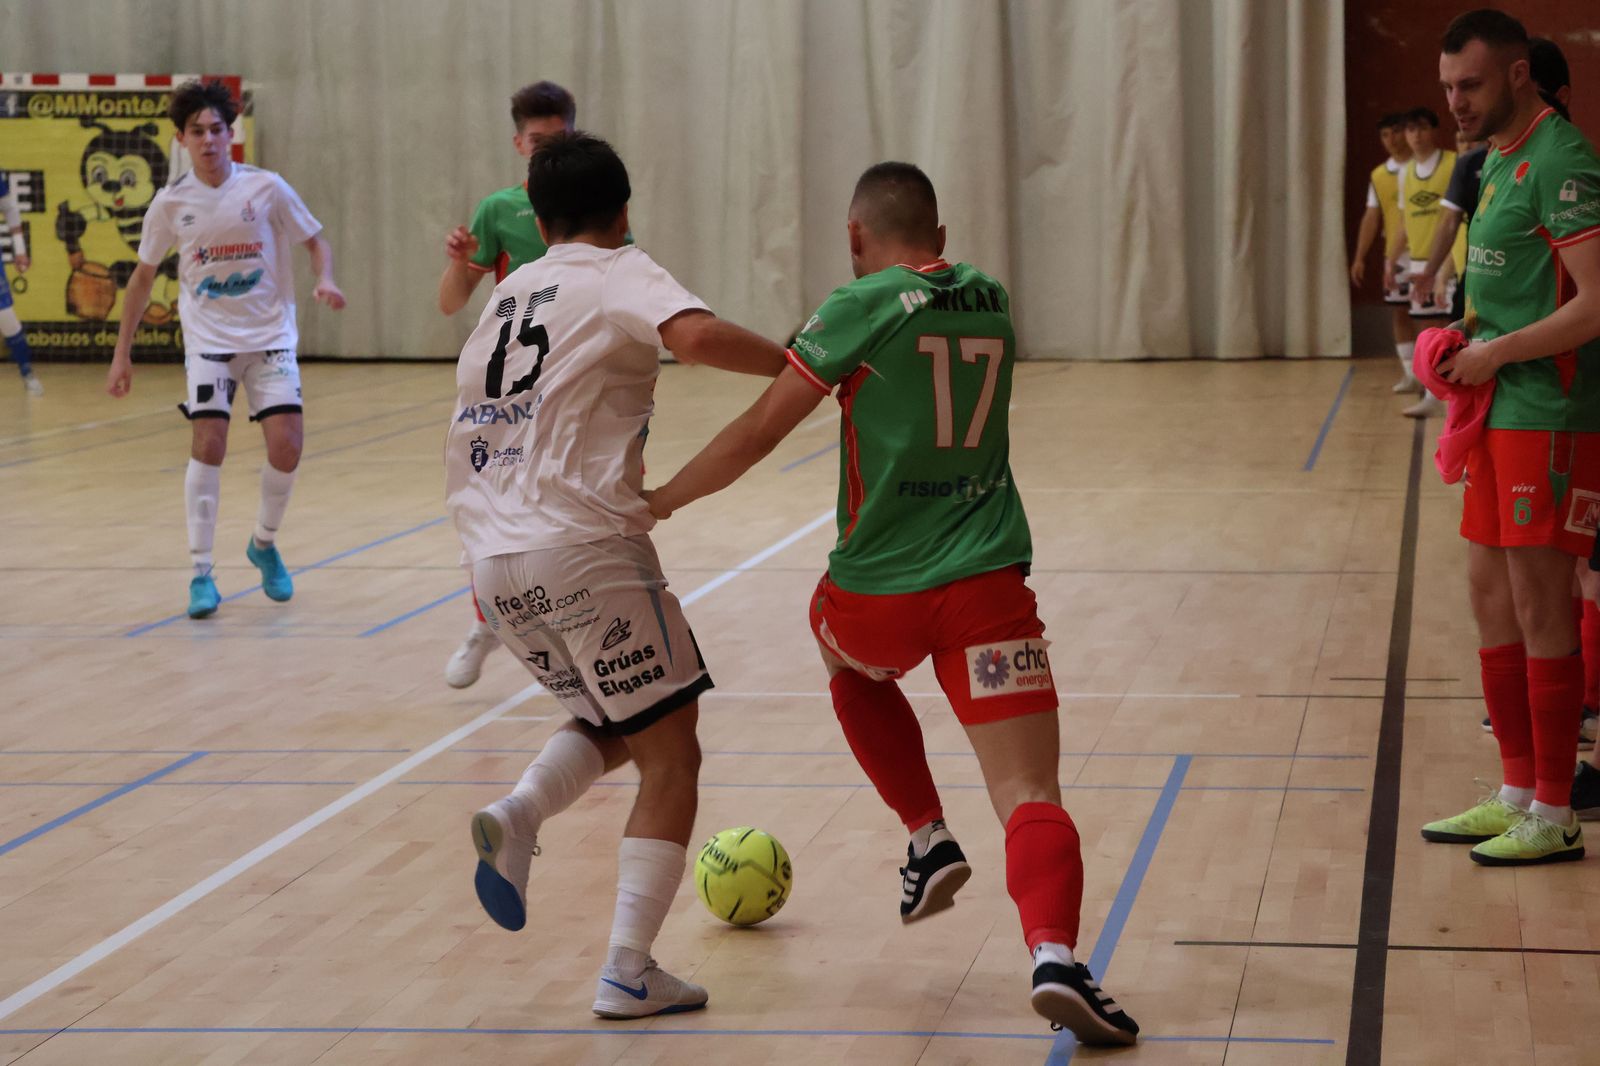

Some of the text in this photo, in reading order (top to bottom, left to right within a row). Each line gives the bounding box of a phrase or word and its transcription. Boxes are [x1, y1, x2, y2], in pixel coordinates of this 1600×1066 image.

[28, 93, 170, 119] @MMonteA
[27, 330, 90, 347] abazos
[131, 330, 171, 346] liste
[486, 284, 559, 399] 15
[917, 335, 1004, 449] 17
[457, 394, 543, 425] ABAN
[1512, 483, 1537, 493] vive
[1513, 497, 1532, 525] 6
[494, 585, 546, 616] freco
[594, 644, 656, 678] Grúas
[598, 663, 665, 698] Elgasa
